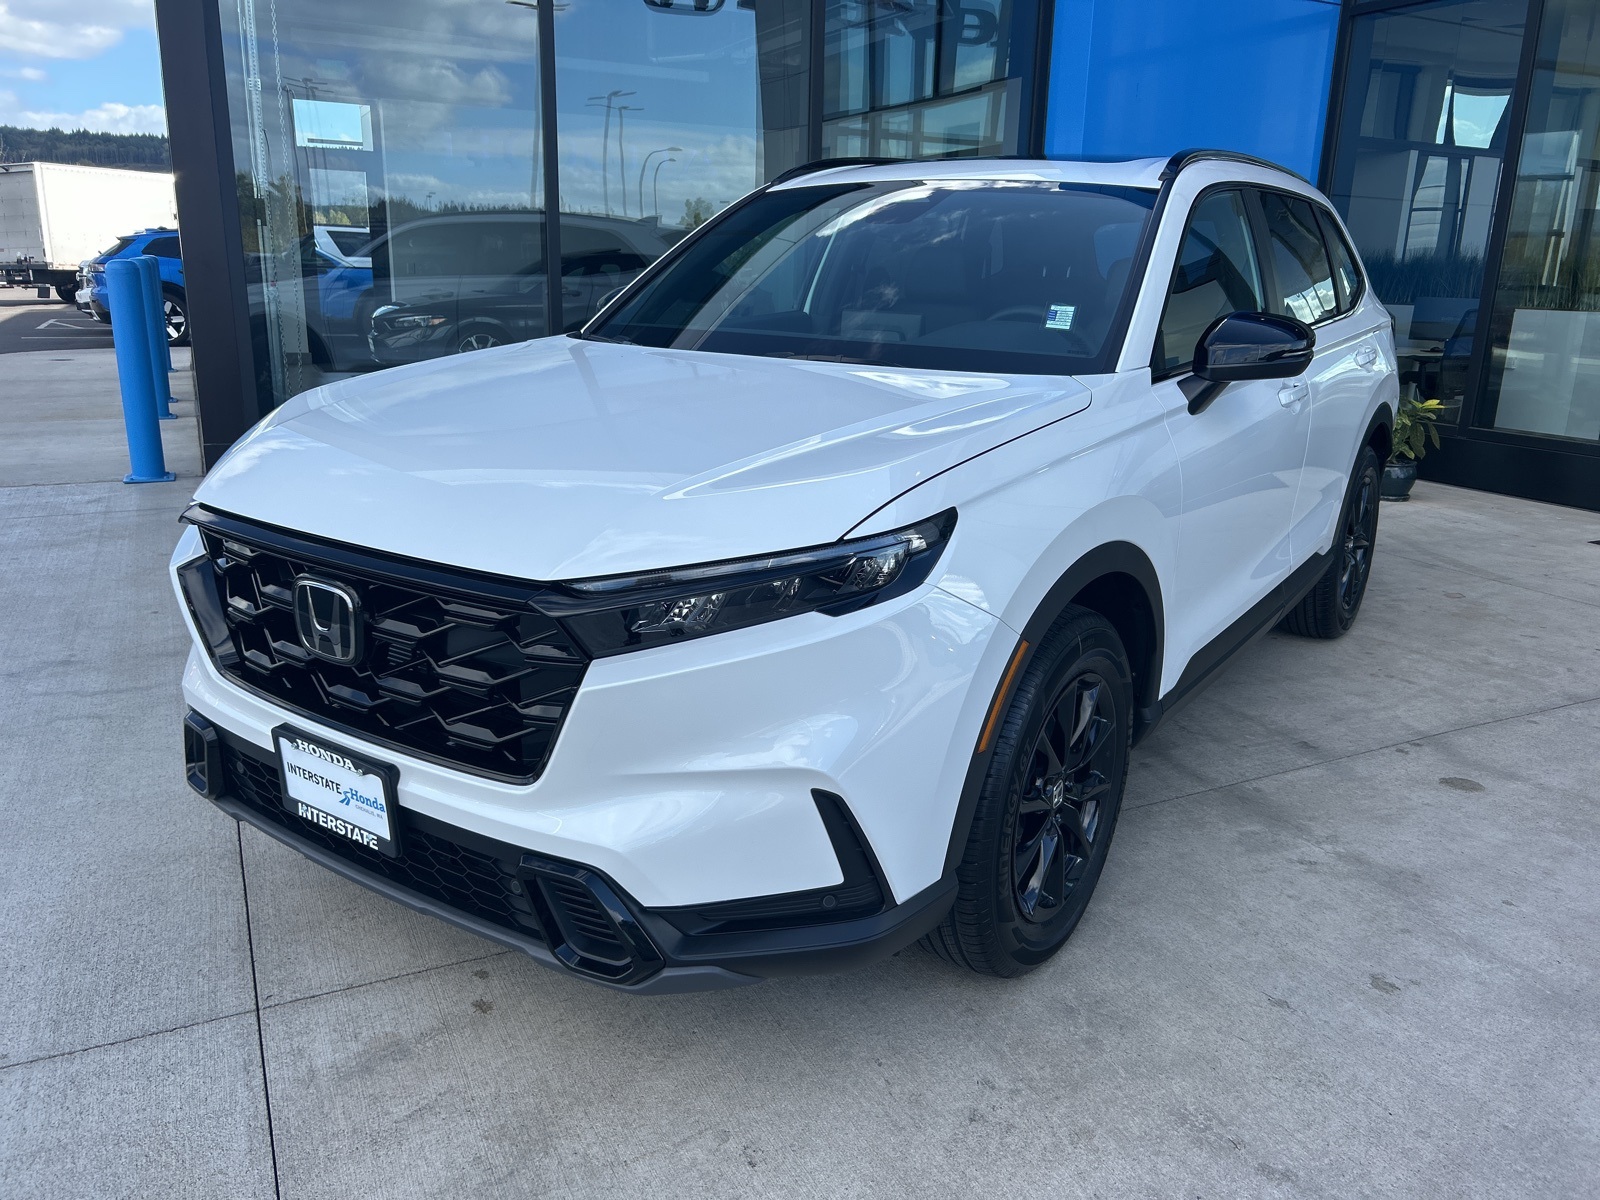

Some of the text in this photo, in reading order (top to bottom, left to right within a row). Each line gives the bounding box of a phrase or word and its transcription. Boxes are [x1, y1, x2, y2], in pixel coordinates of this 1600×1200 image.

[296, 739, 357, 773] HONDA
[287, 762, 342, 795] INTERSTATE
[349, 787, 386, 813] Honda
[298, 803, 379, 850] INTERSTATE
